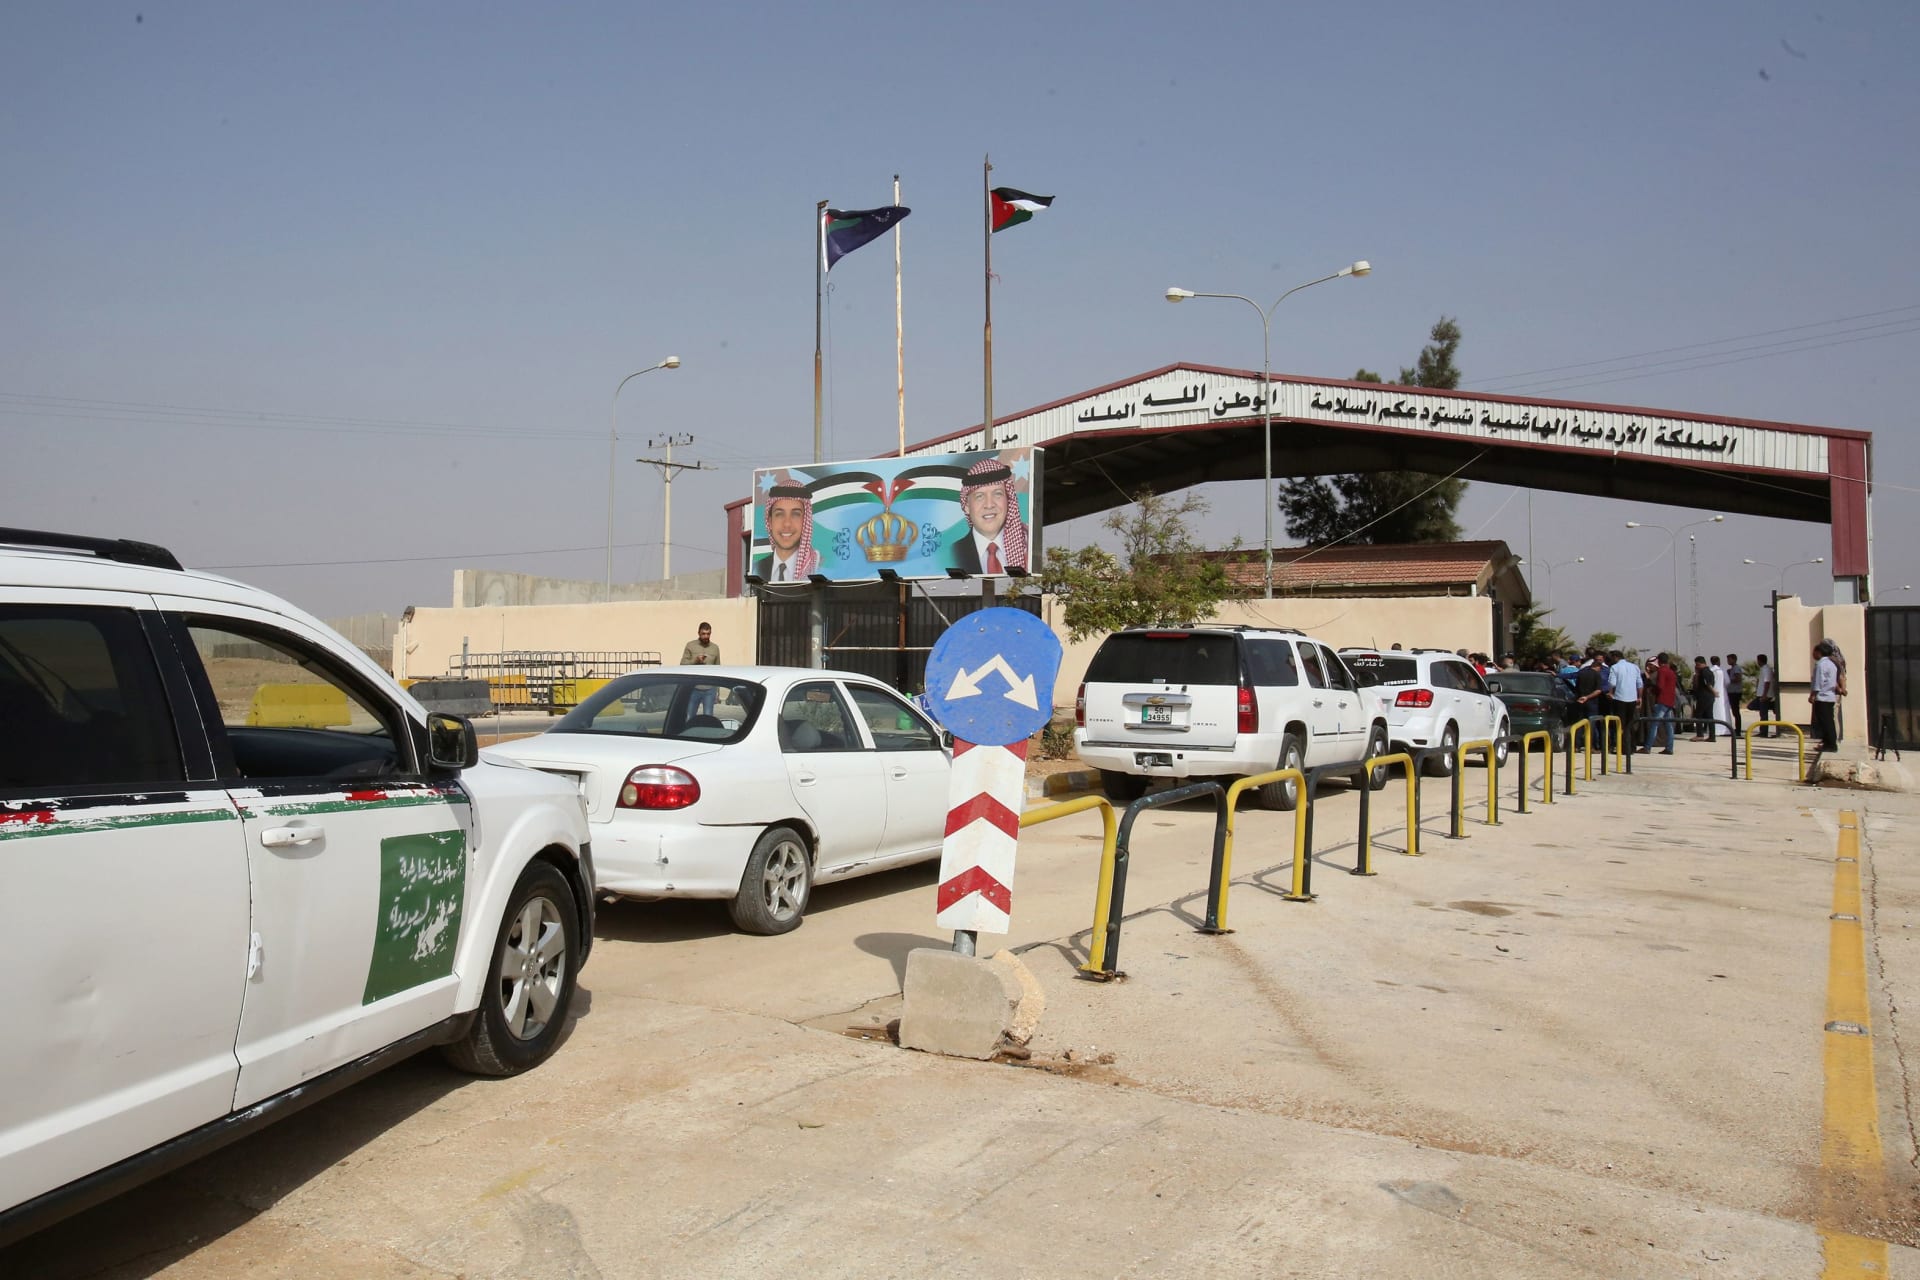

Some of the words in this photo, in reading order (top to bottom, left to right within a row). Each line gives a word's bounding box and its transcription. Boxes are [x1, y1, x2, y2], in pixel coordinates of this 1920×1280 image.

[1143, 383, 1206, 407] الله
[1311, 391, 1377, 417] السلامة
[1078, 402, 1136, 423] الملك
[1378, 400, 1474, 427] تستودعكم
[1480, 411, 1568, 439] الهاشمية
[1570, 415, 1647, 446] الأردنية
[1653, 425, 1738, 456] المملكة
[1154, 706, 1164, 714] 50
